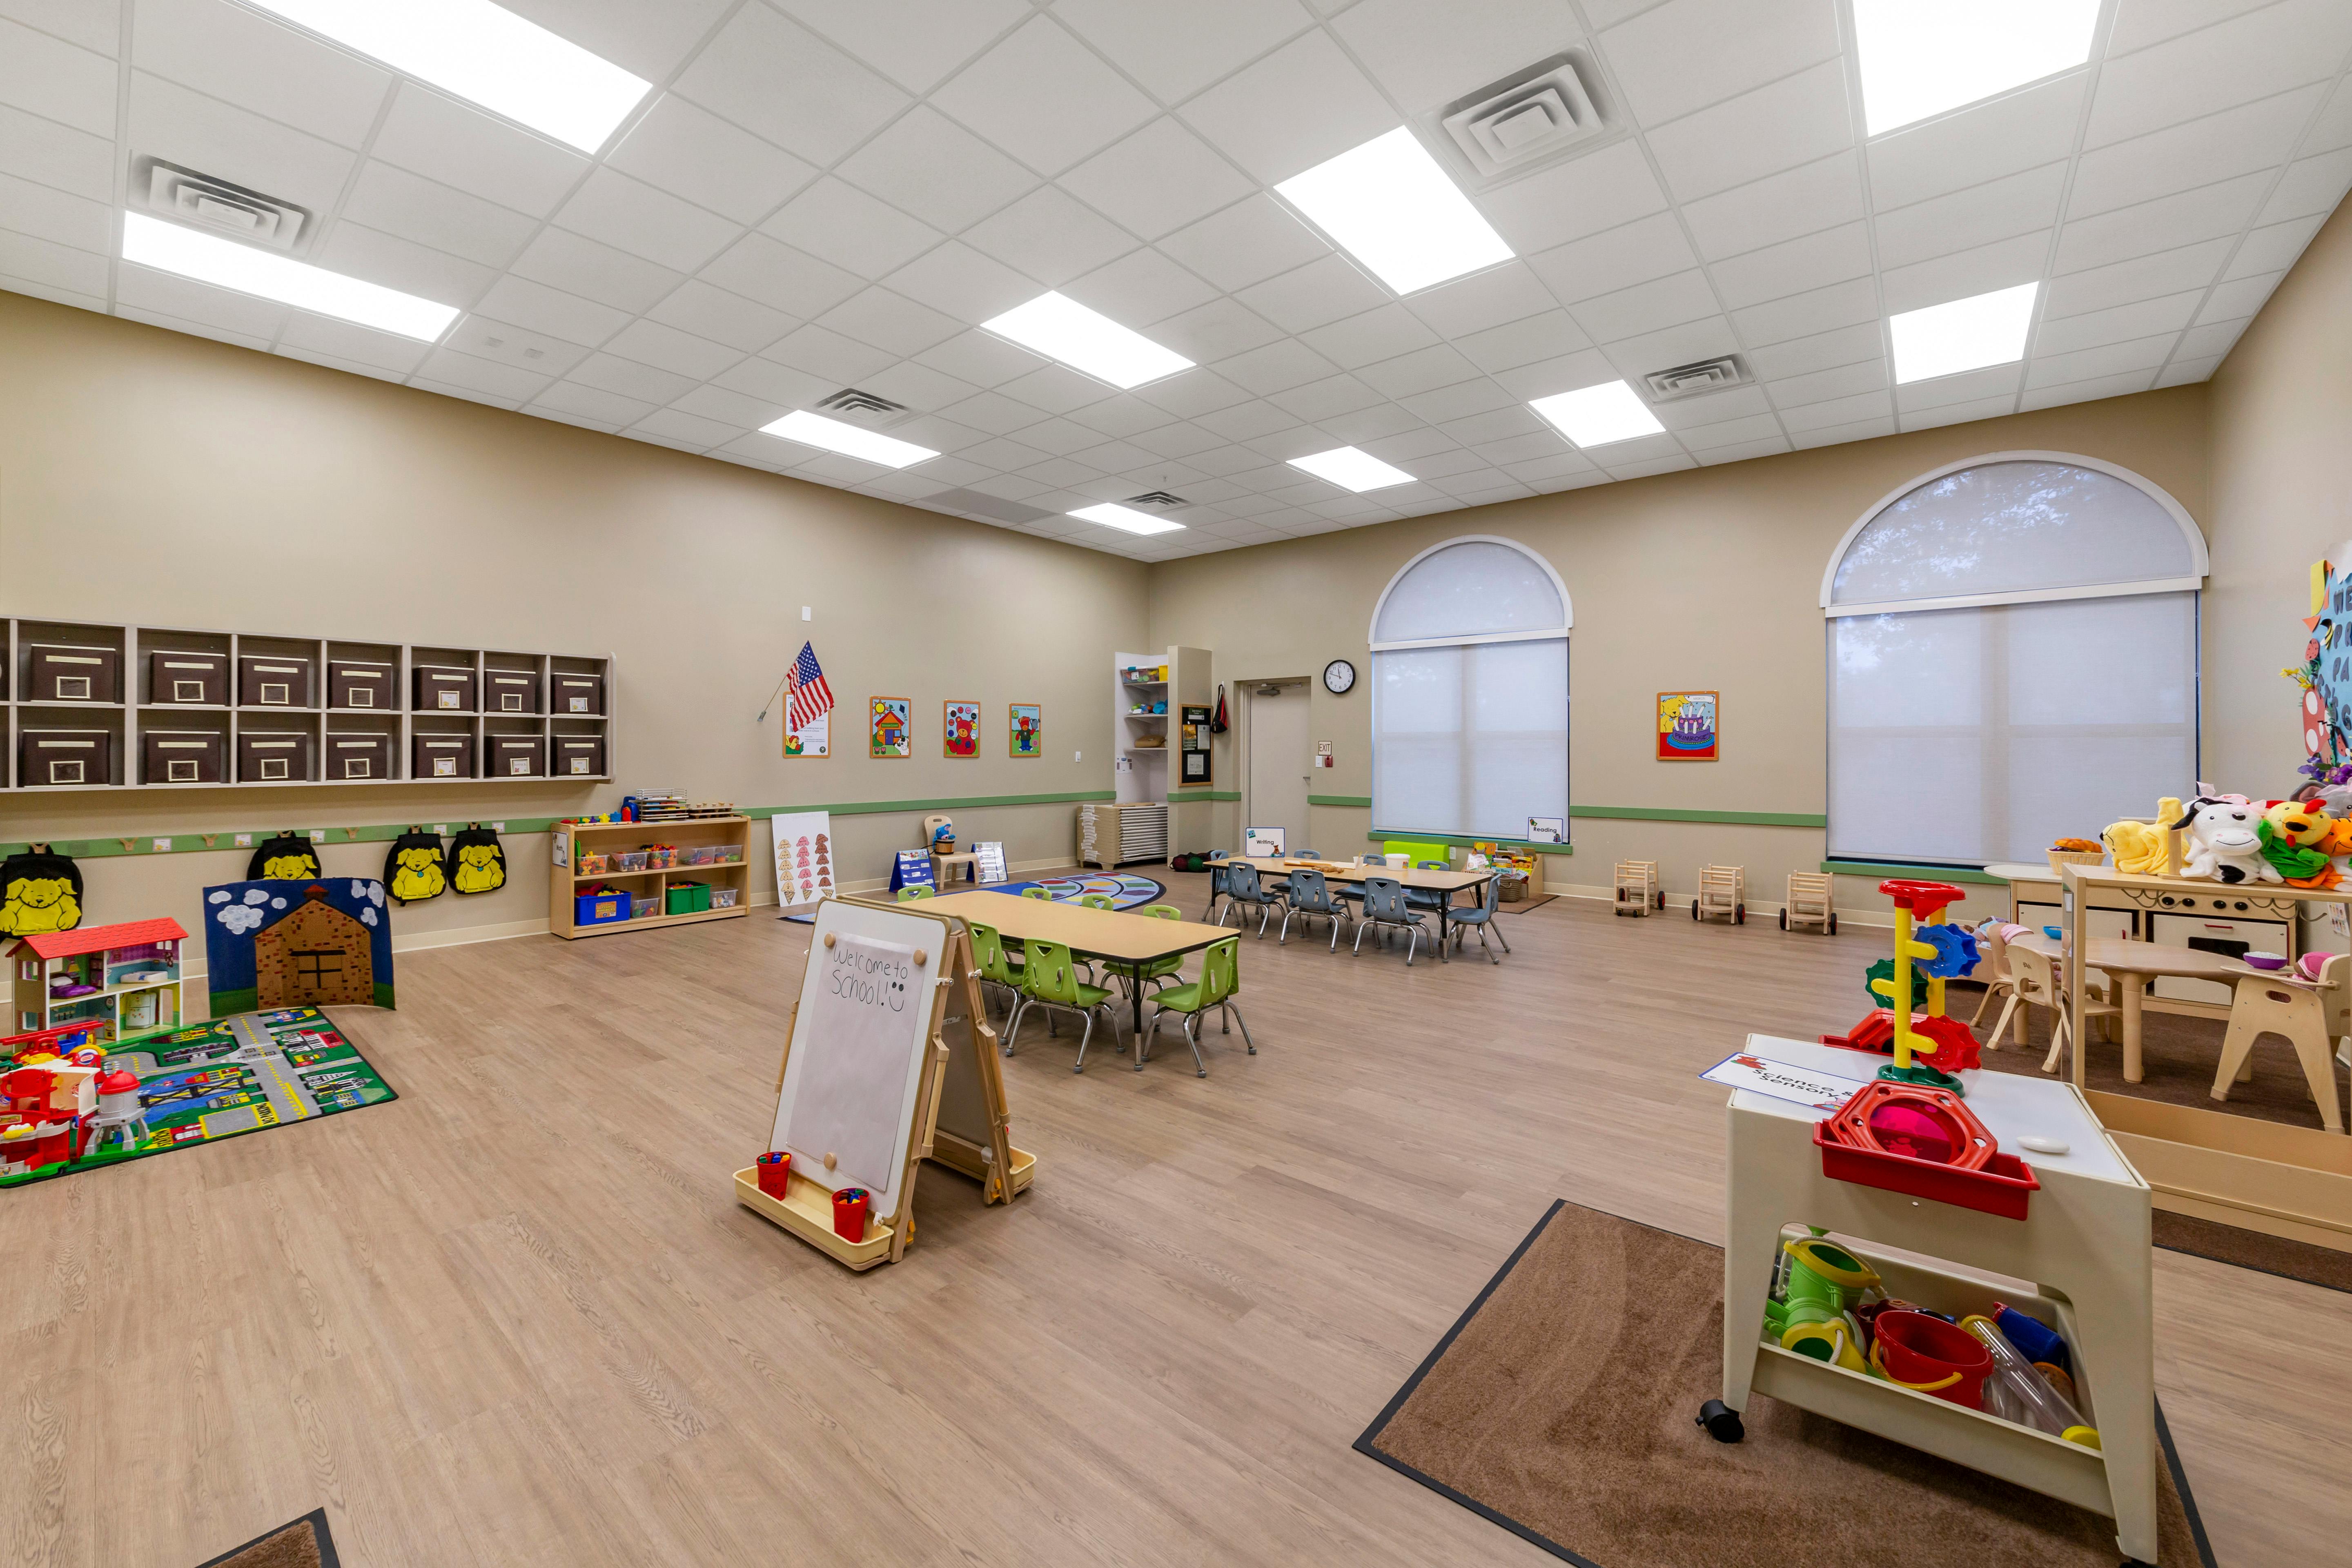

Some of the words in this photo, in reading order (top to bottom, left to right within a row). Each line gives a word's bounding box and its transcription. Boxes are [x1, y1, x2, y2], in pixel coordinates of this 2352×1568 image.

[1675, 733, 1707, 742] PRIMROSE
[833, 944, 891, 976] Welcome
[894, 961, 908, 979] to
[832, 969, 888, 1006] School!
[1752, 1069, 1835, 1091] Science
[1759, 1076, 1840, 1097] Sensory
